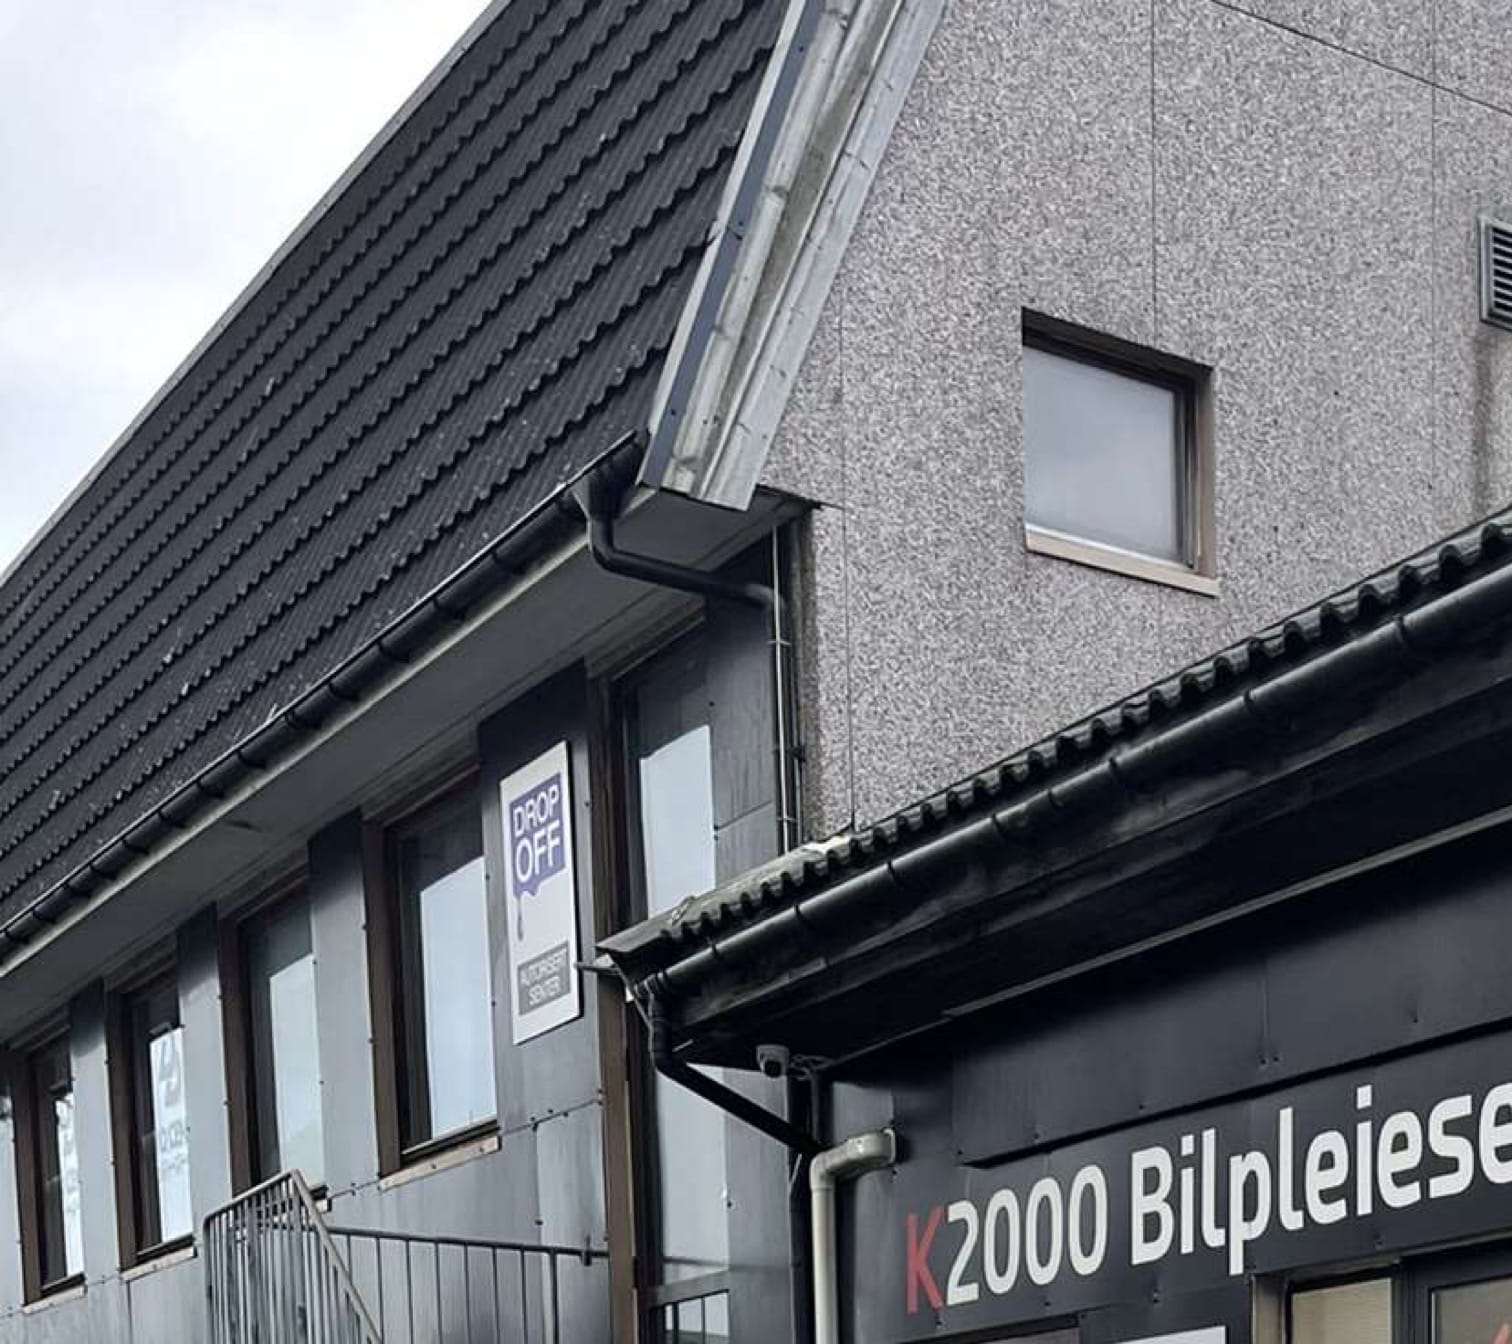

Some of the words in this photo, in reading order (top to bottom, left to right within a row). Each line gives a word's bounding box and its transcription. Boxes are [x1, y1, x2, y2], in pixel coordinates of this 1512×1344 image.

[513, 785, 560, 838] DROP
[515, 820, 560, 883] OFF
[906, 1164, 1108, 1315] K2000
